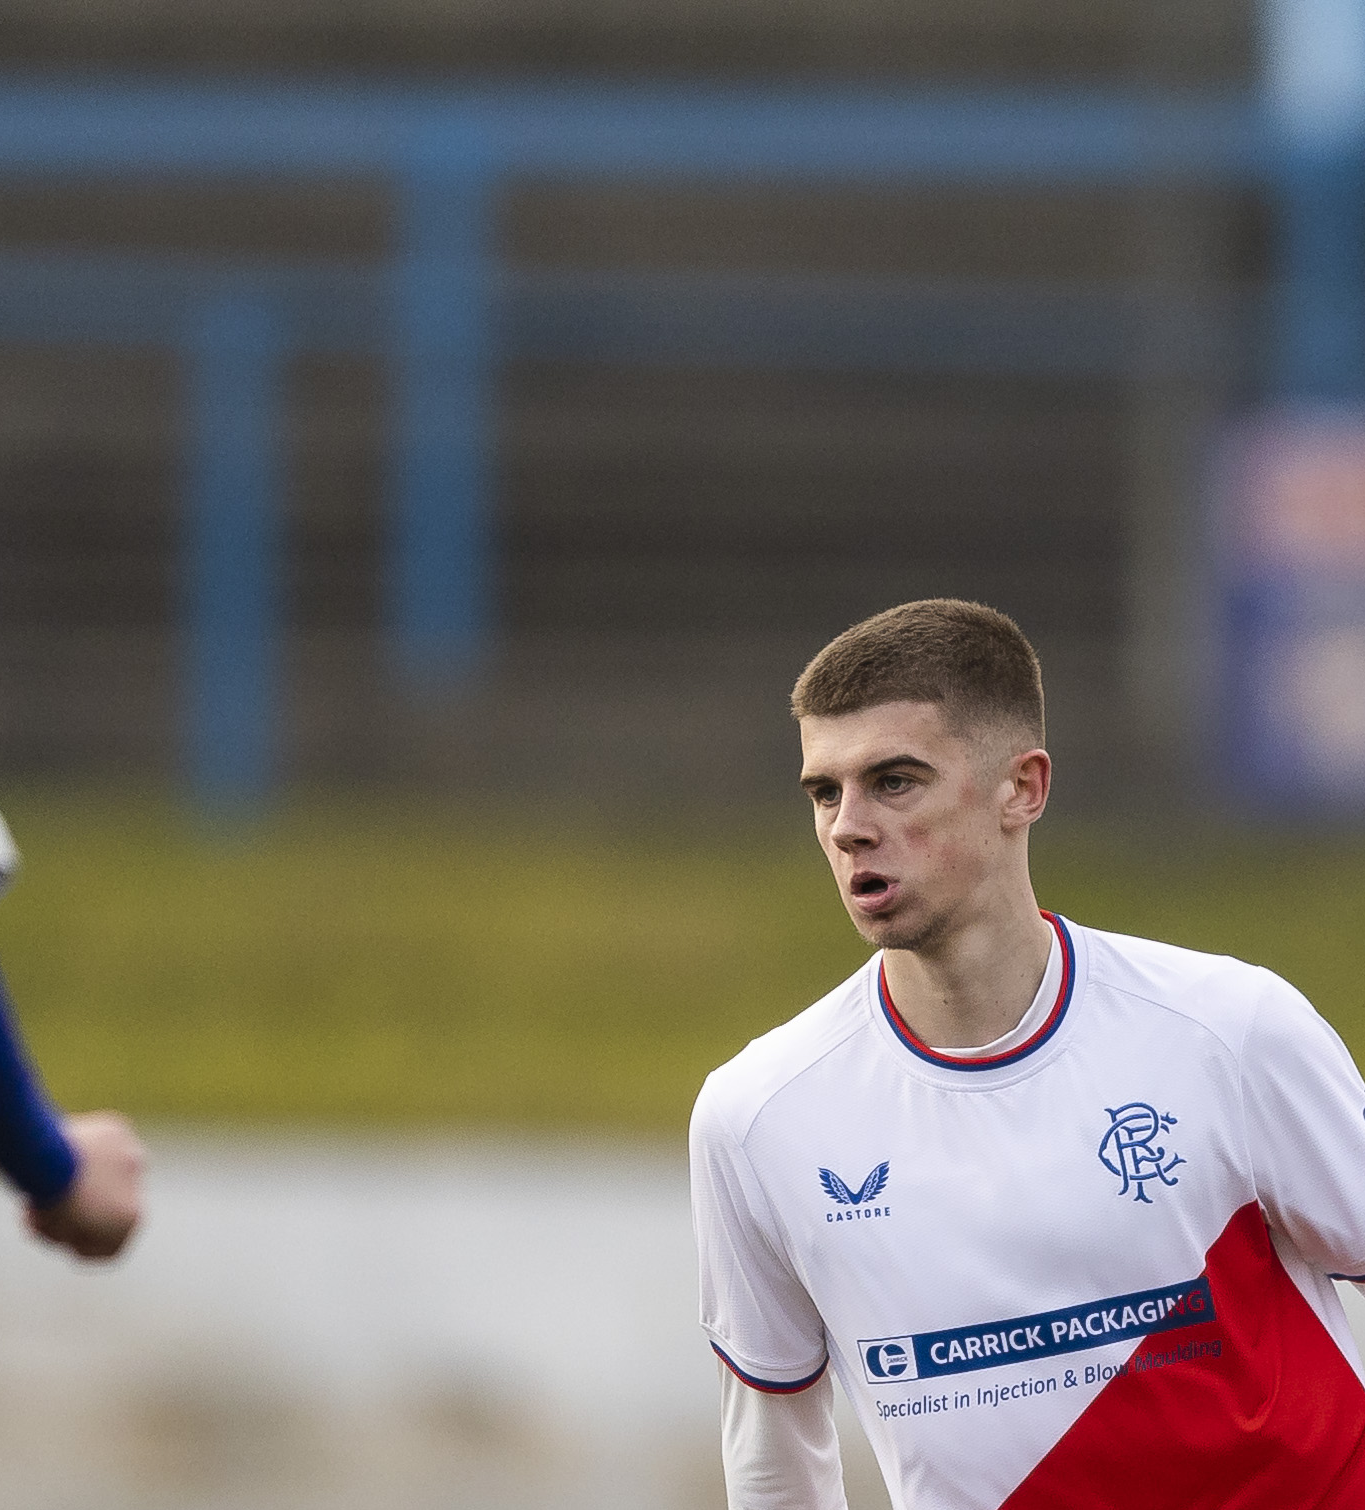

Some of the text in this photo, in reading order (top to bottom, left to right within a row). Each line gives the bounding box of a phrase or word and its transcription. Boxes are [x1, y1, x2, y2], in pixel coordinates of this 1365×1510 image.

[826, 1206, 891, 1223] CASTORE
[930, 1290, 1205, 1365] CARRICK PACKAGING
[876, 1339, 1222, 1421] Specialist in Injection & Blow Moulding
